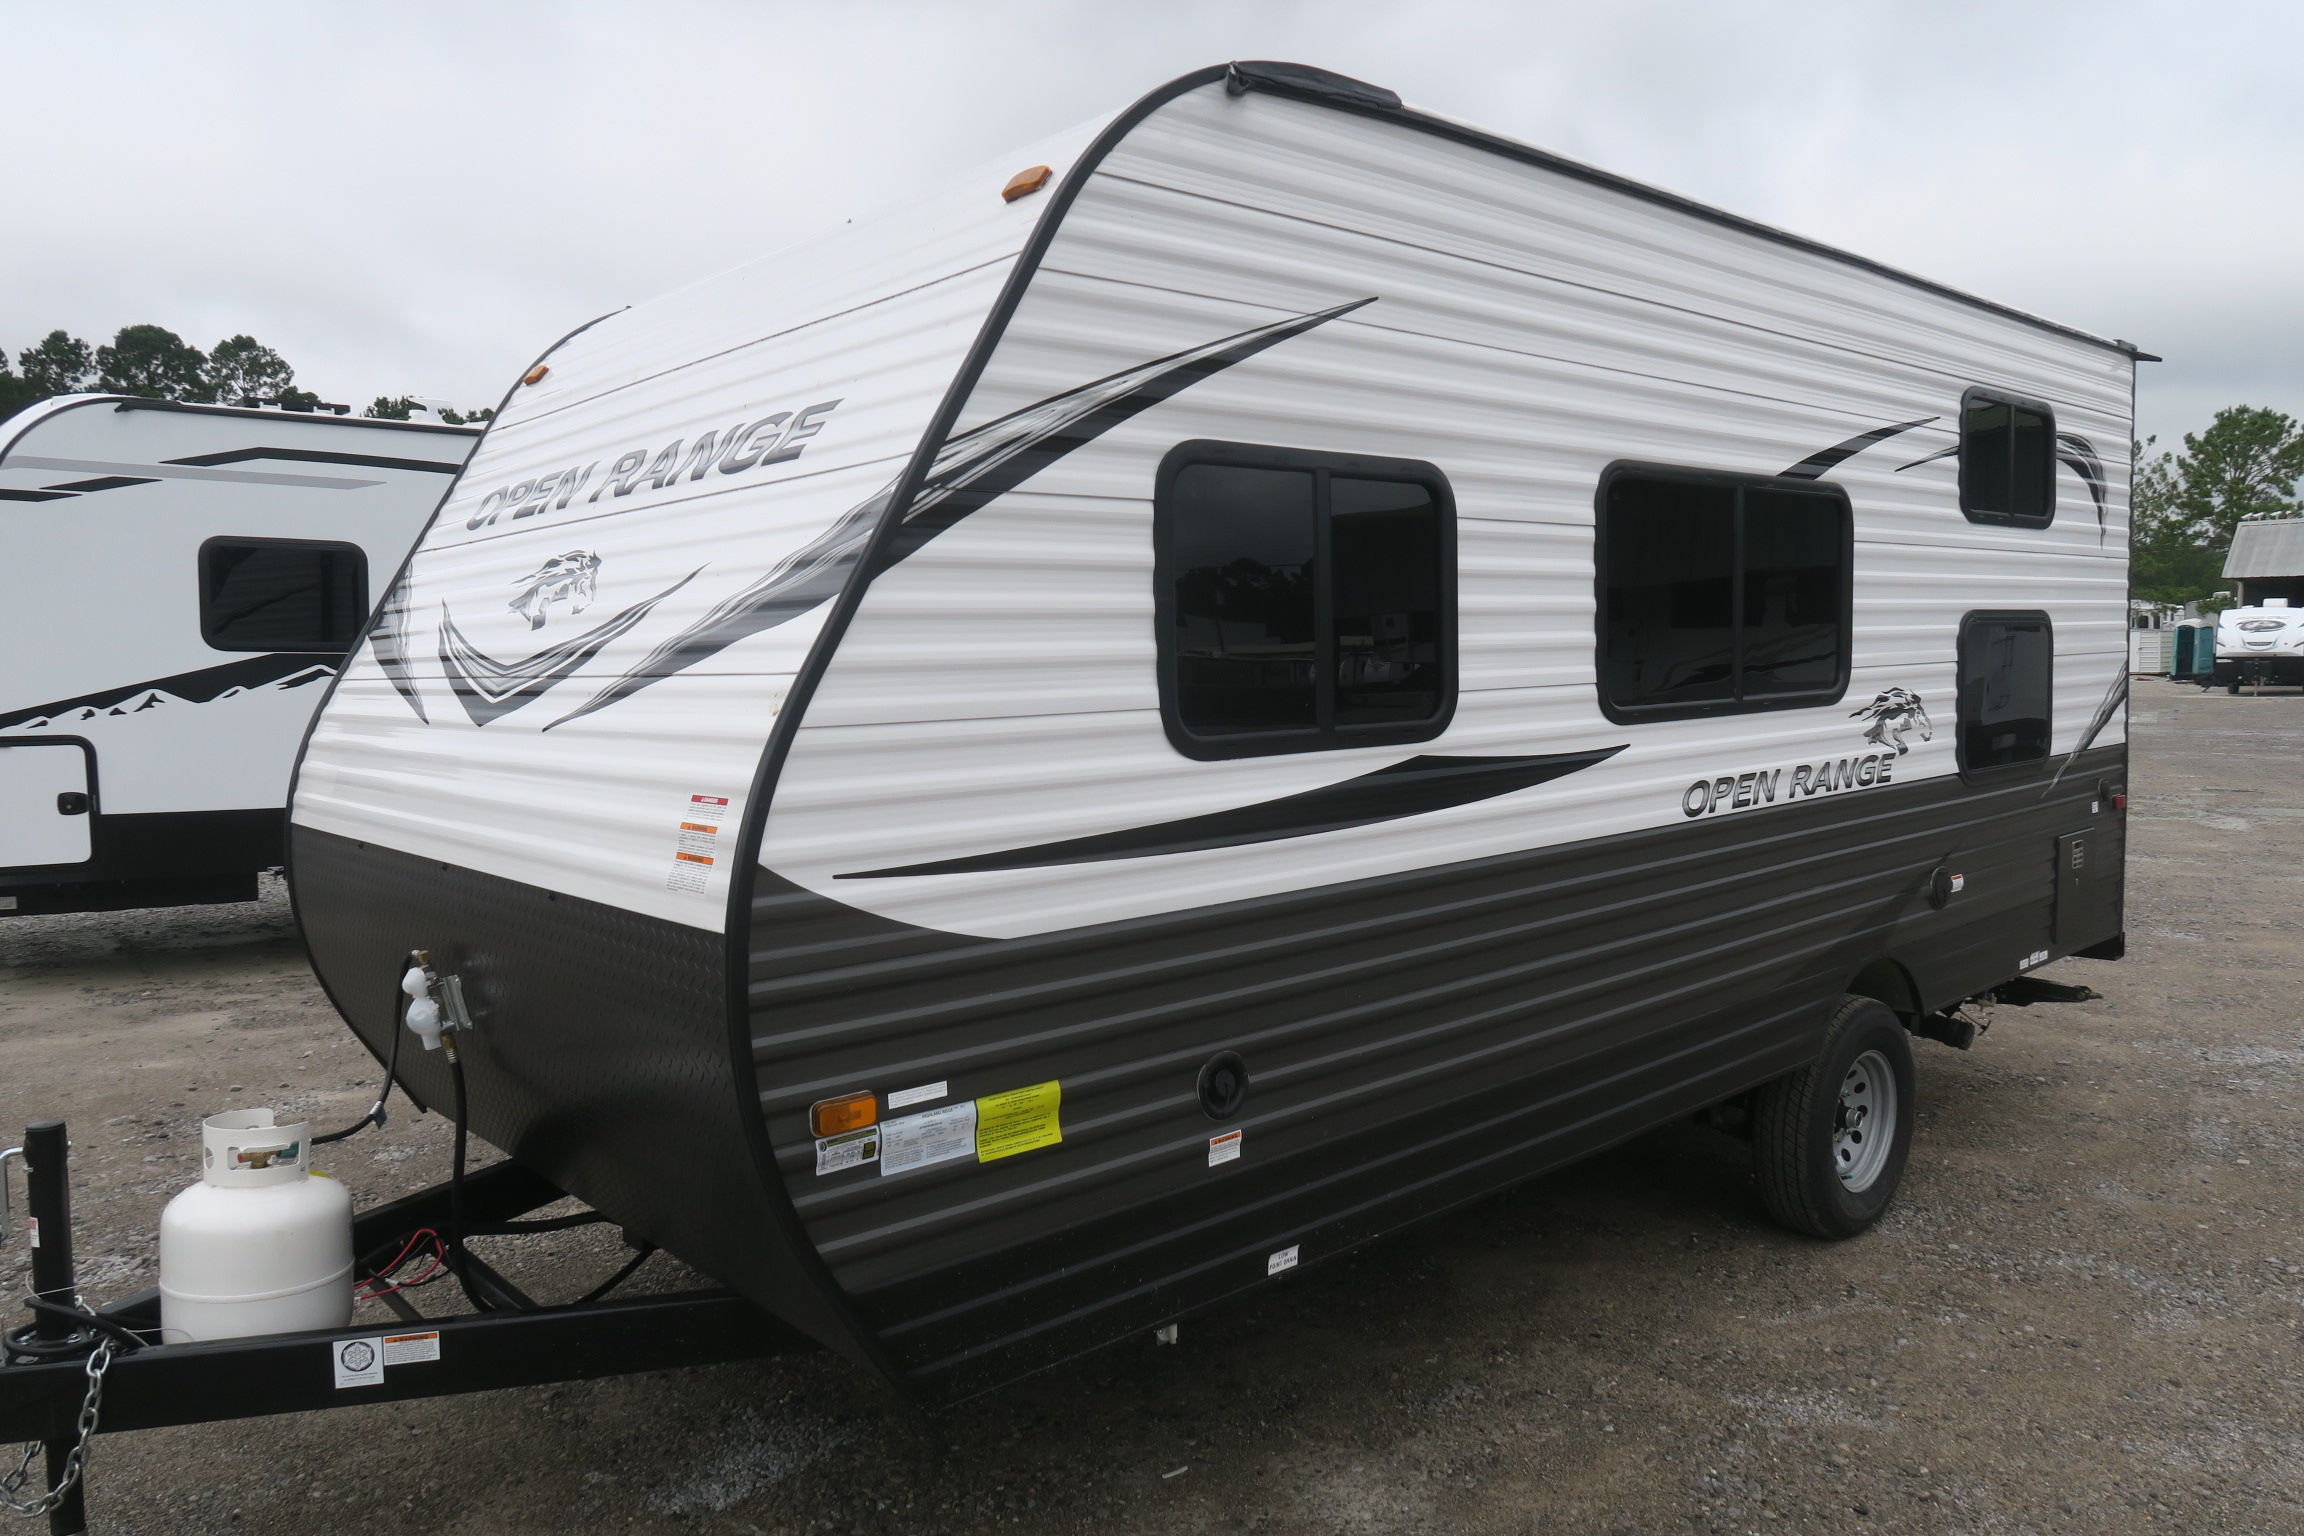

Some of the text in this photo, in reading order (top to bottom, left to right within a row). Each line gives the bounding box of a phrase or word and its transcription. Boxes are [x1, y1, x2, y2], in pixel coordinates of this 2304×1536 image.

[466, 398, 846, 531] OPEN RANGE
[1682, 752, 1896, 818] OPEN RANGE
[1269, 1260, 1283, 1270] POINT
[1278, 1252, 1289, 1260] LOW
